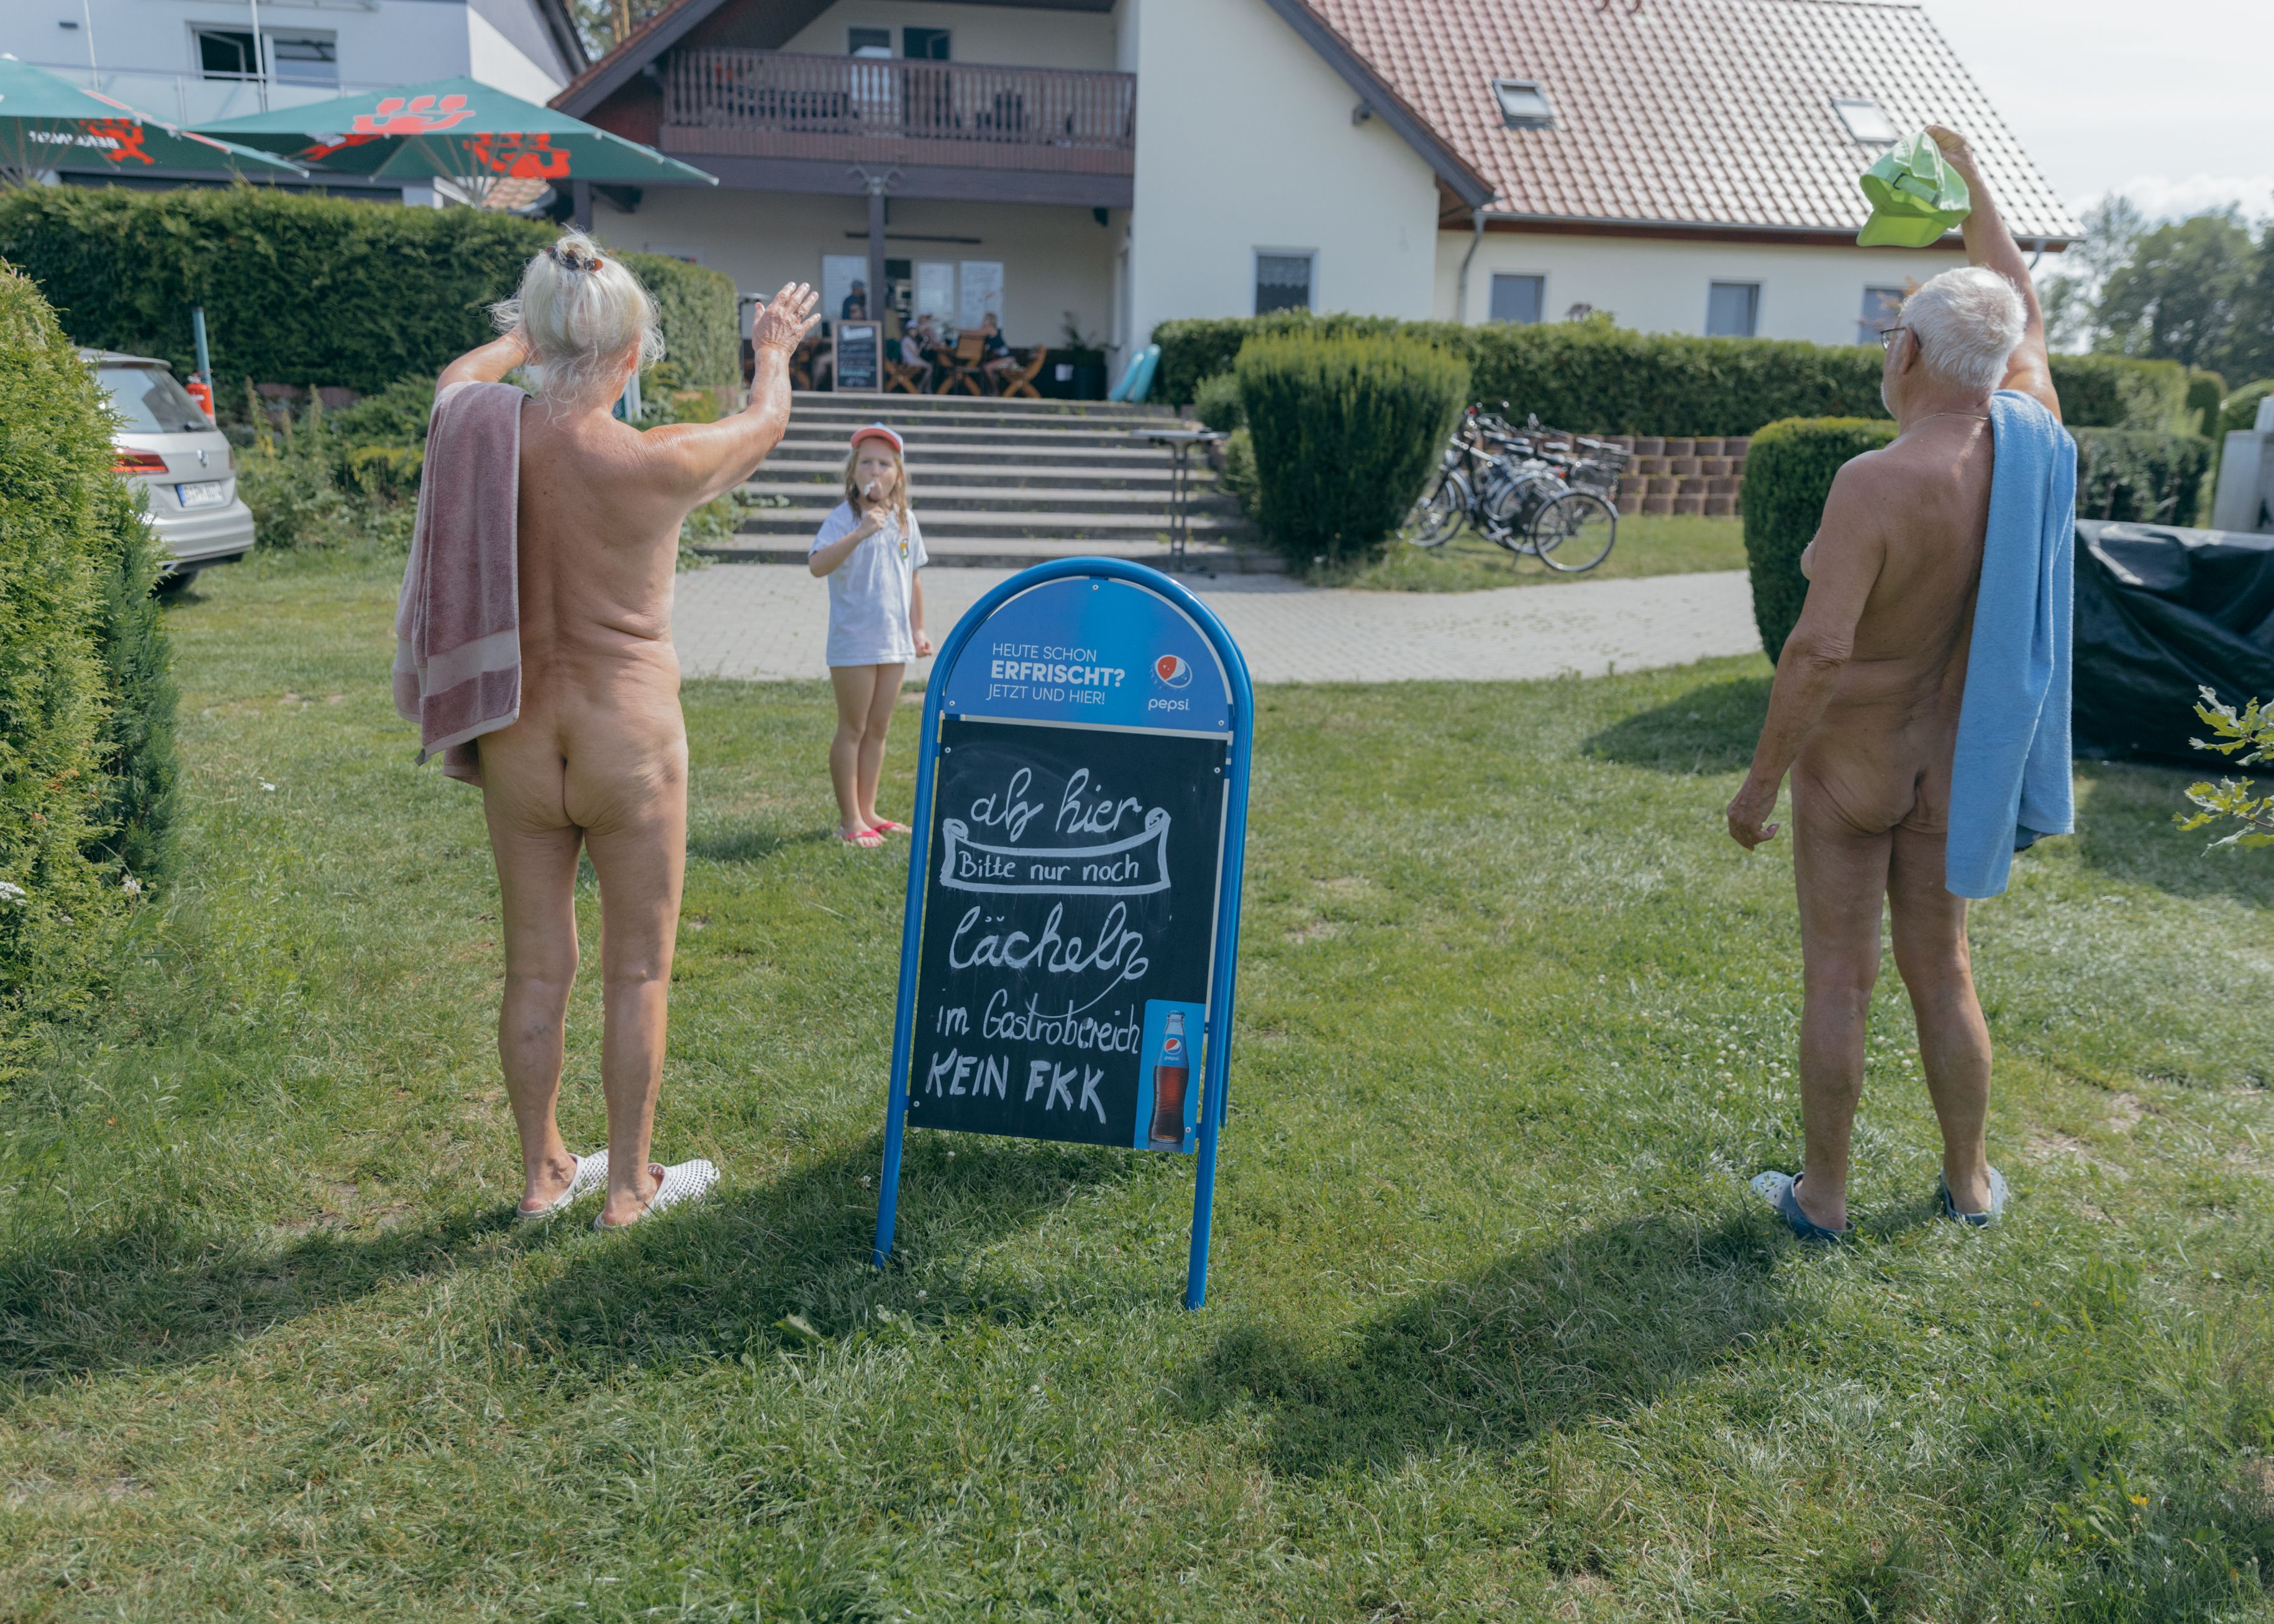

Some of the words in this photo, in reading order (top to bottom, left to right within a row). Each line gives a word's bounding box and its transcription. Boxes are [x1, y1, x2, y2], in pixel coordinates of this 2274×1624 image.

[993, 643, 1039, 659] HEUTE
[1043, 646, 1097, 663] SCHON
[991, 660, 1126, 687] ERFRISCHT?
[986, 684, 1029, 701] JETZT
[1032, 687, 1065, 702] UND
[1070, 689, 1106, 705] HIER!
[1147, 698, 1189, 712] pepsi
[971, 768, 1044, 842] ab
[1055, 768, 1142, 833] hier
[958, 850, 1016, 878] Bitte
[1030, 863, 1071, 881] nur
[1083, 854, 1139, 881] noch
[949, 901, 1149, 980] lächeln
[925, 1048, 1009, 1100] KEIN
[1026, 1059, 1107, 1124] FKK
